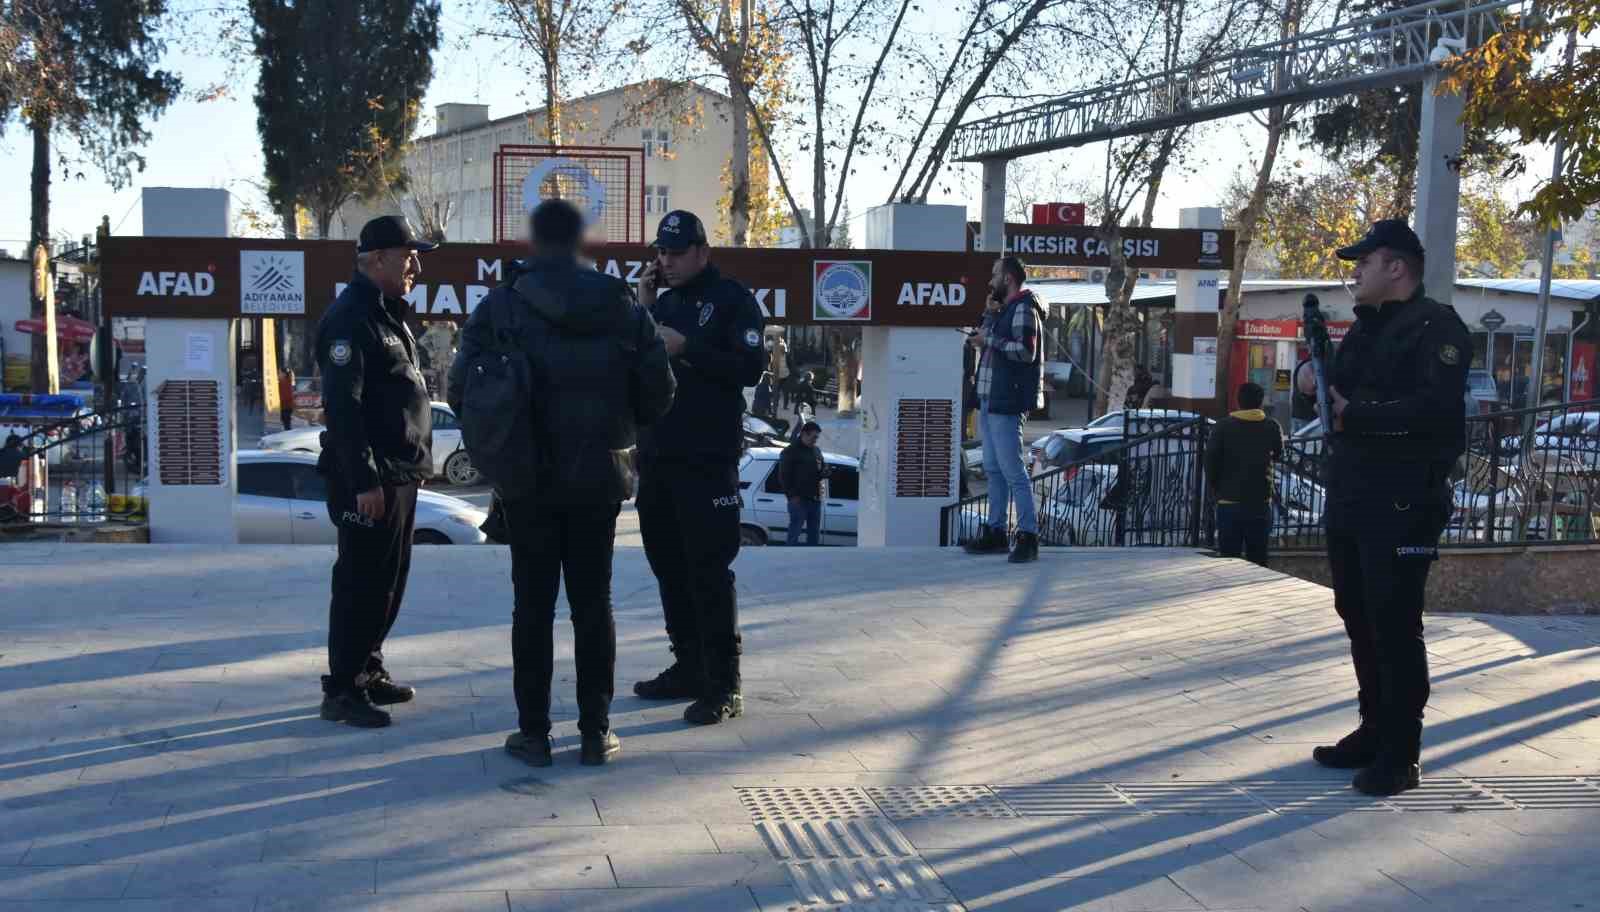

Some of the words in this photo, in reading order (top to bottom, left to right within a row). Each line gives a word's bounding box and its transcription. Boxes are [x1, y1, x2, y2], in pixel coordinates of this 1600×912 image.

[973, 232, 1077, 256] BLIKESİR
[1083, 237, 1159, 258] ÇAŞISI
[136, 271, 215, 296] AFAD
[896, 282, 966, 306] AFAD
[244, 292, 303, 302] ADIYAMAN
